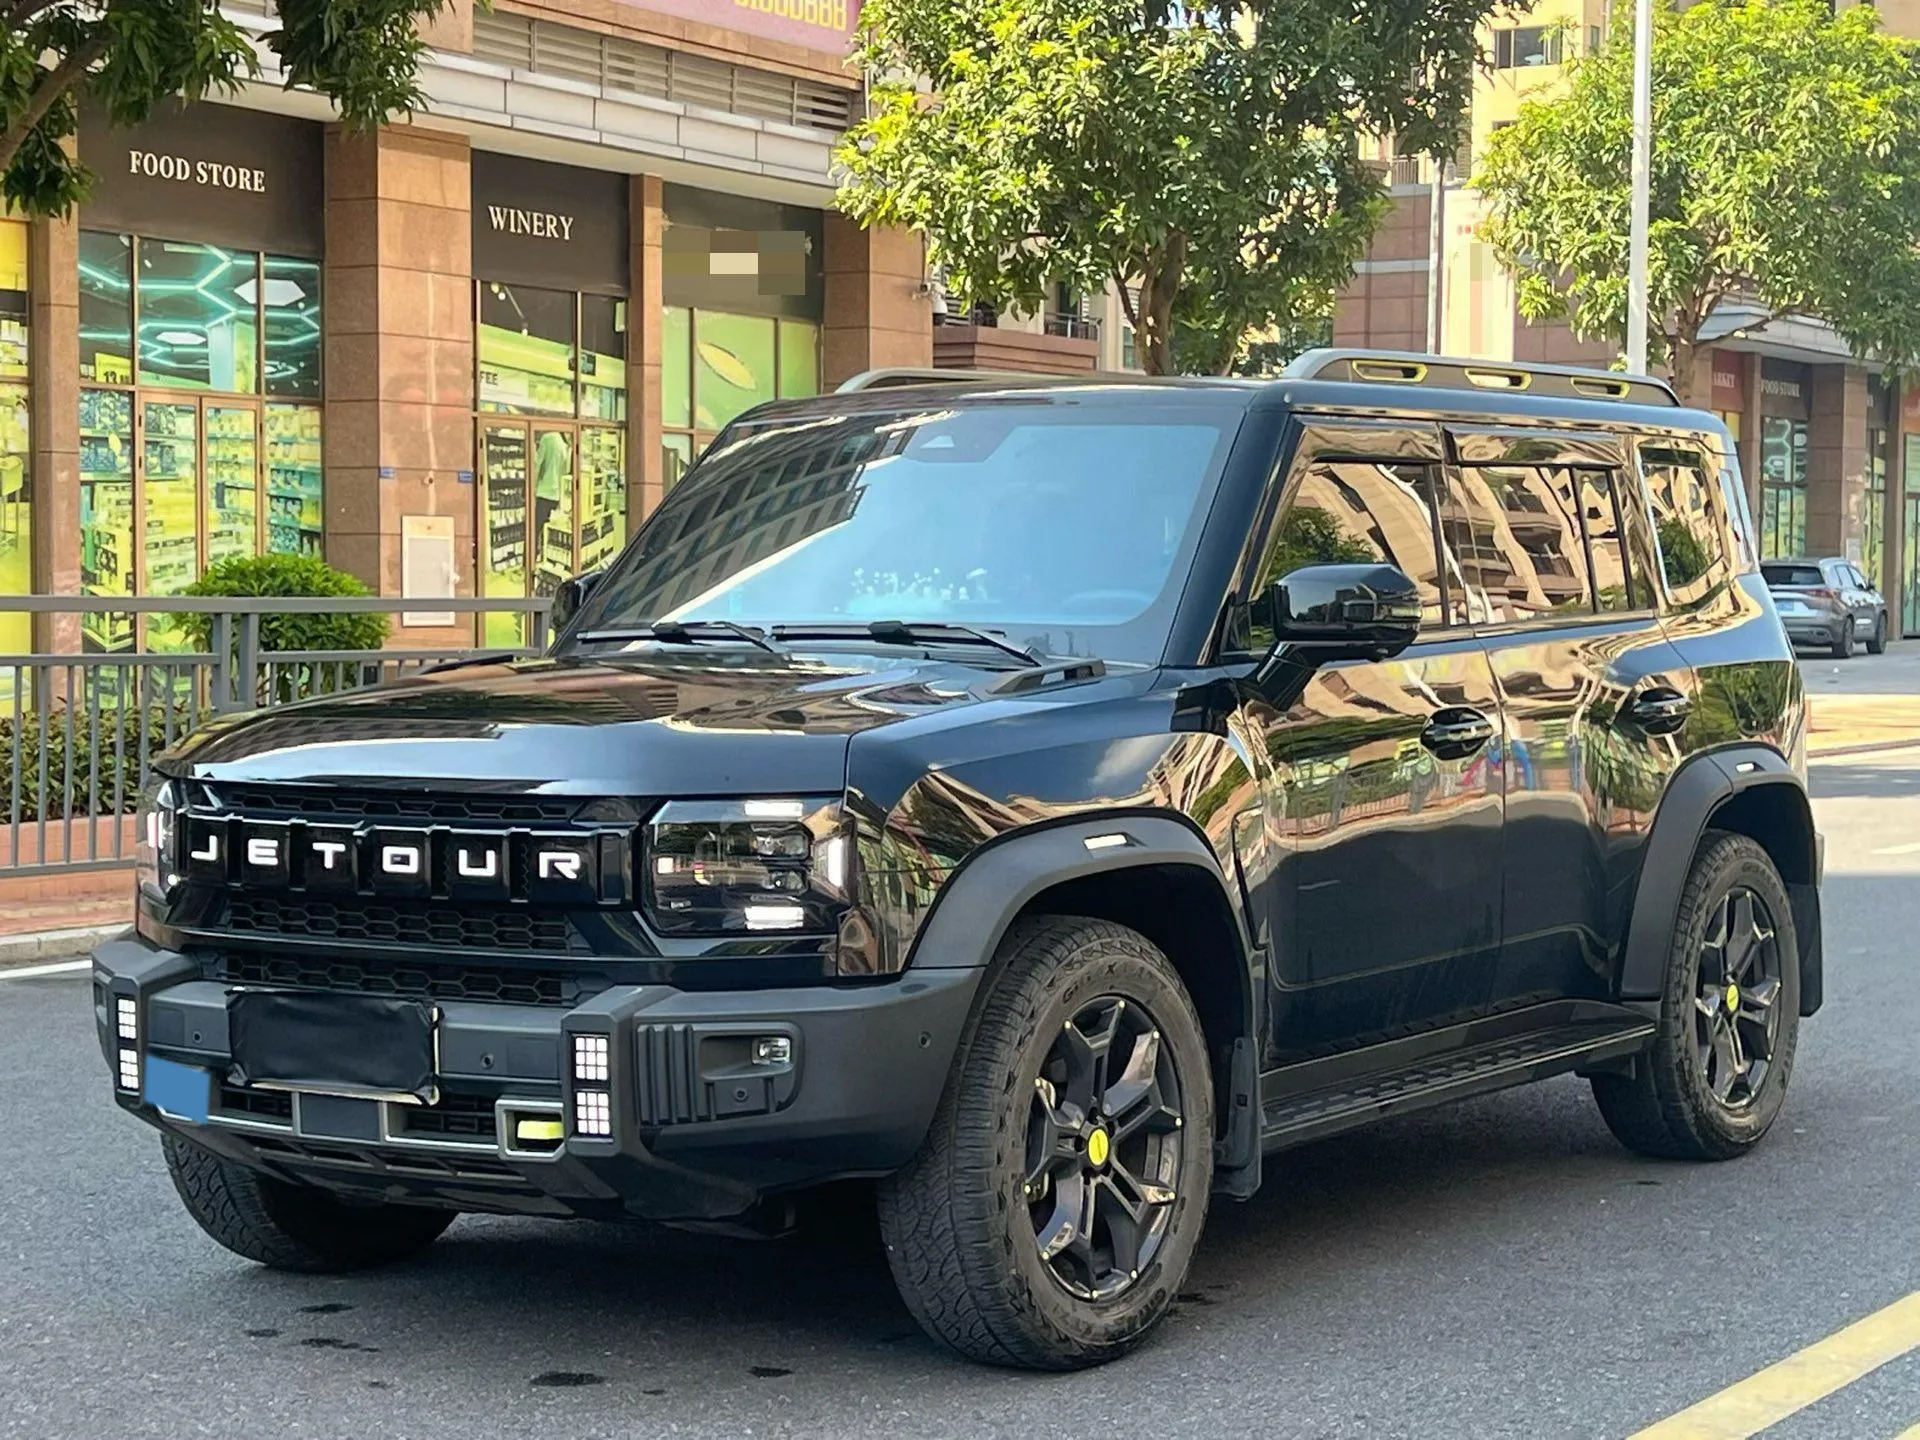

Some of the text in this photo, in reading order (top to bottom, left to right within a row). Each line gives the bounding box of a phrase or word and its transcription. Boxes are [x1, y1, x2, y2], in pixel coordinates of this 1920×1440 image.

[129, 150, 266, 192] FOOD STORE
[487, 205, 574, 240] WINERY
[191, 834, 582, 881] JETOUR
